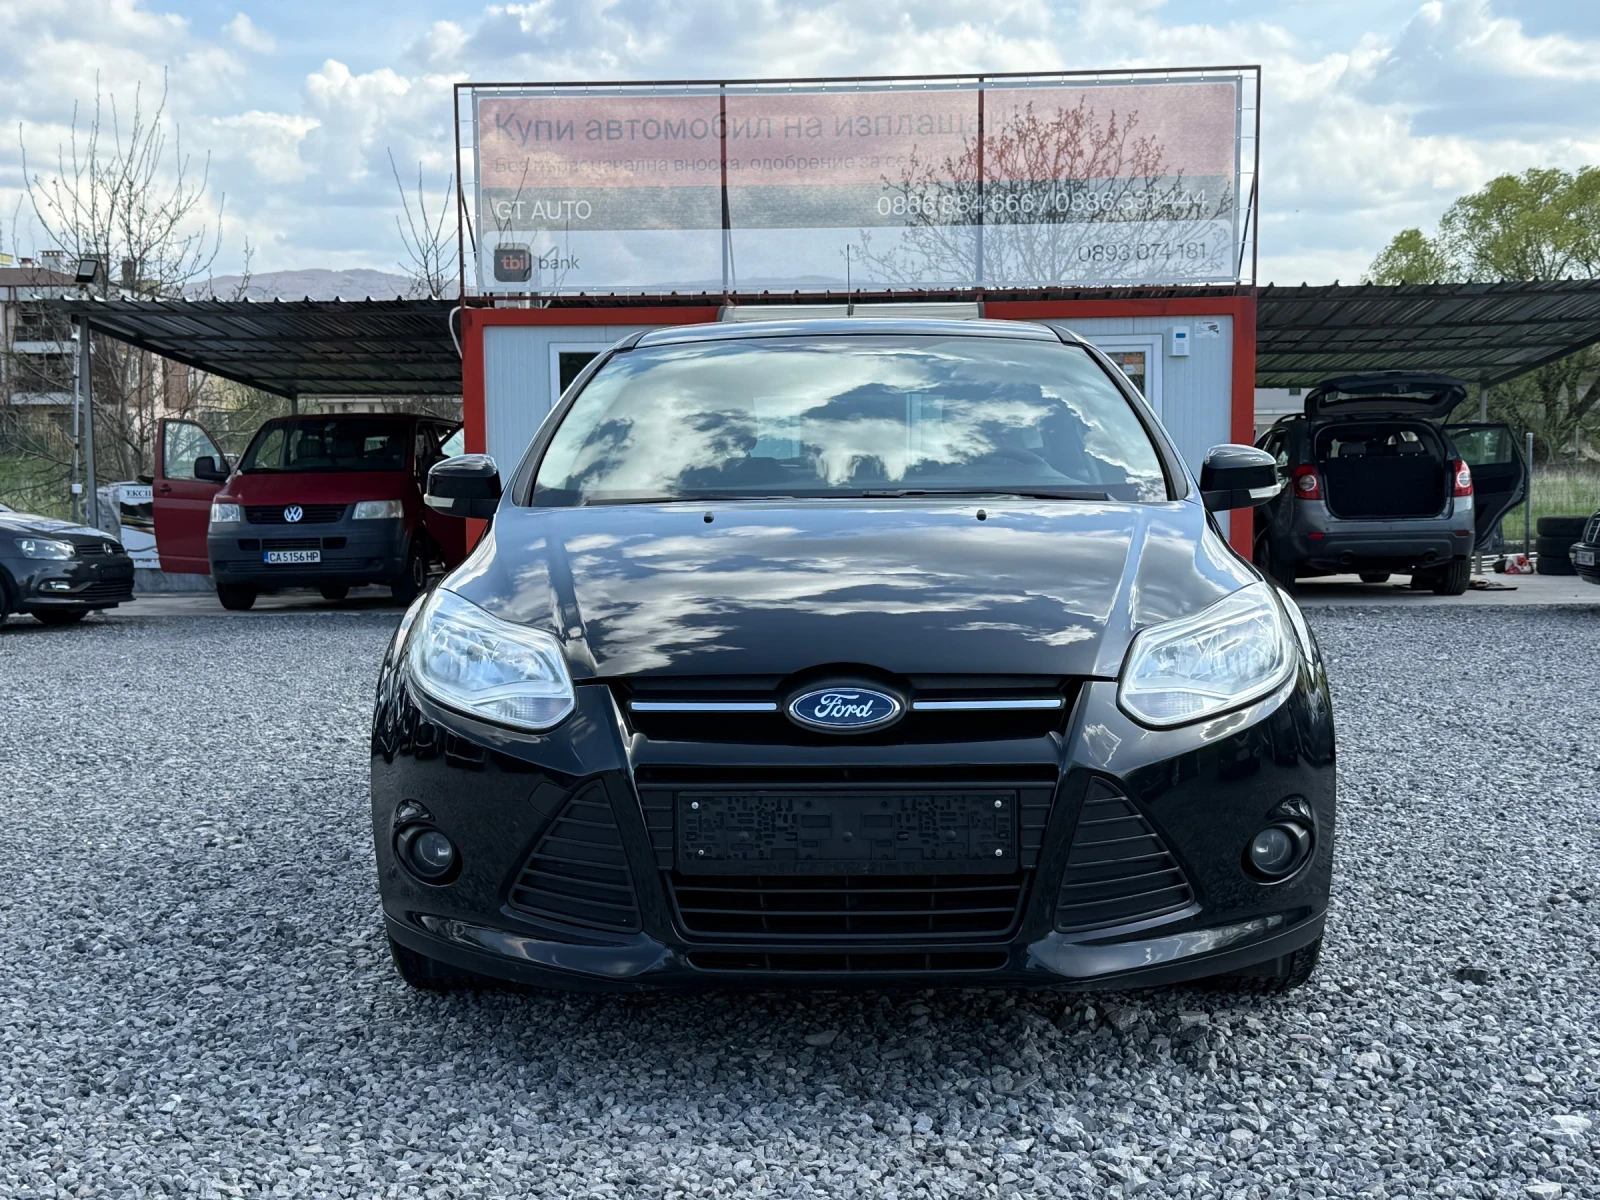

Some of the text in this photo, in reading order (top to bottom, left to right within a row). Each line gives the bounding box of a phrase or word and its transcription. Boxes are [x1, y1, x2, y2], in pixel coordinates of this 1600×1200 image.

[496, 112, 574, 147] Купи
[585, 111, 772, 141] автомобил
[784, 115, 823, 139] на
[495, 157, 526, 173] Без
[750, 153, 855, 175] одобрение
[860, 156, 880, 169] за
[496, 199, 592, 220] GT AUTO
[877, 195, 935, 215] 0886
[942, 193, 987, 214] 884
[991, 193, 1034, 213] 666
[1055, 191, 1114, 212] 0886
[501, 254, 580, 271] tbi bank
[1078, 244, 1131, 262] 0893
[1177, 242, 1206, 259] 181
[283, 552, 305, 562] 5156
[814, 693, 873, 718] Ford
